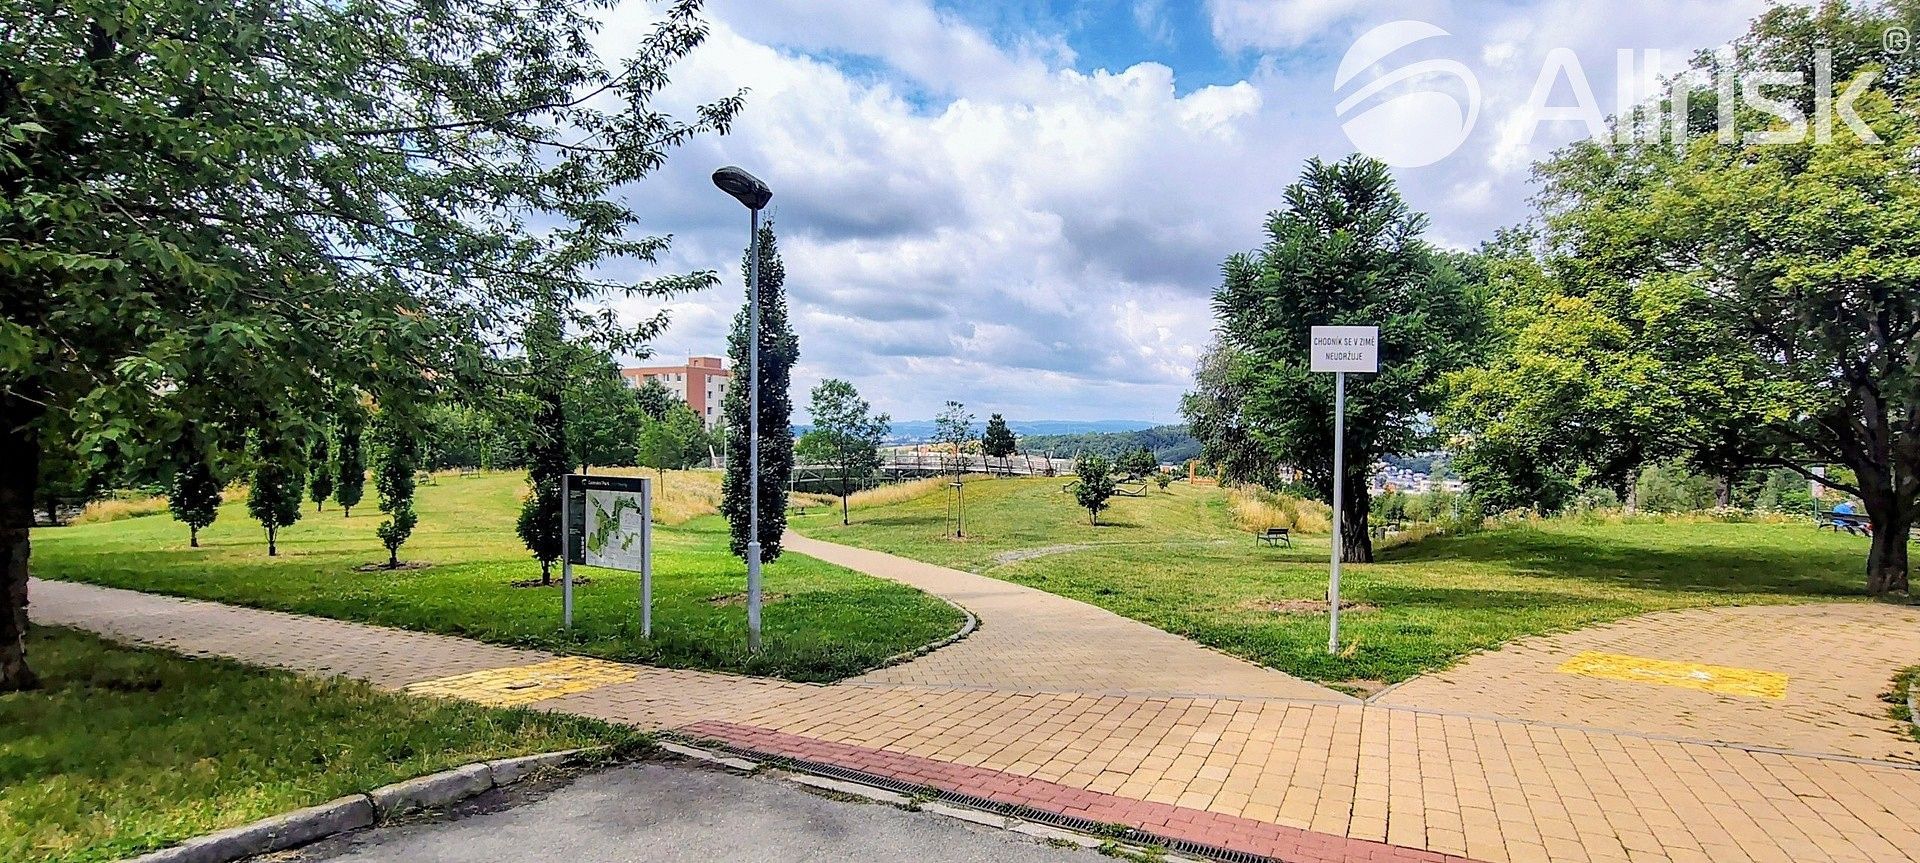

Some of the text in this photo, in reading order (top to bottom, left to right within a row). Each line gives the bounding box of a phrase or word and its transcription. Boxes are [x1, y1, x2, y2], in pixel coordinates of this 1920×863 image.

[1313, 336, 1342, 346] CHODNÍK
[1344, 337, 1352, 346] SE
[1326, 351, 1362, 360] NEUDRŽUJE
